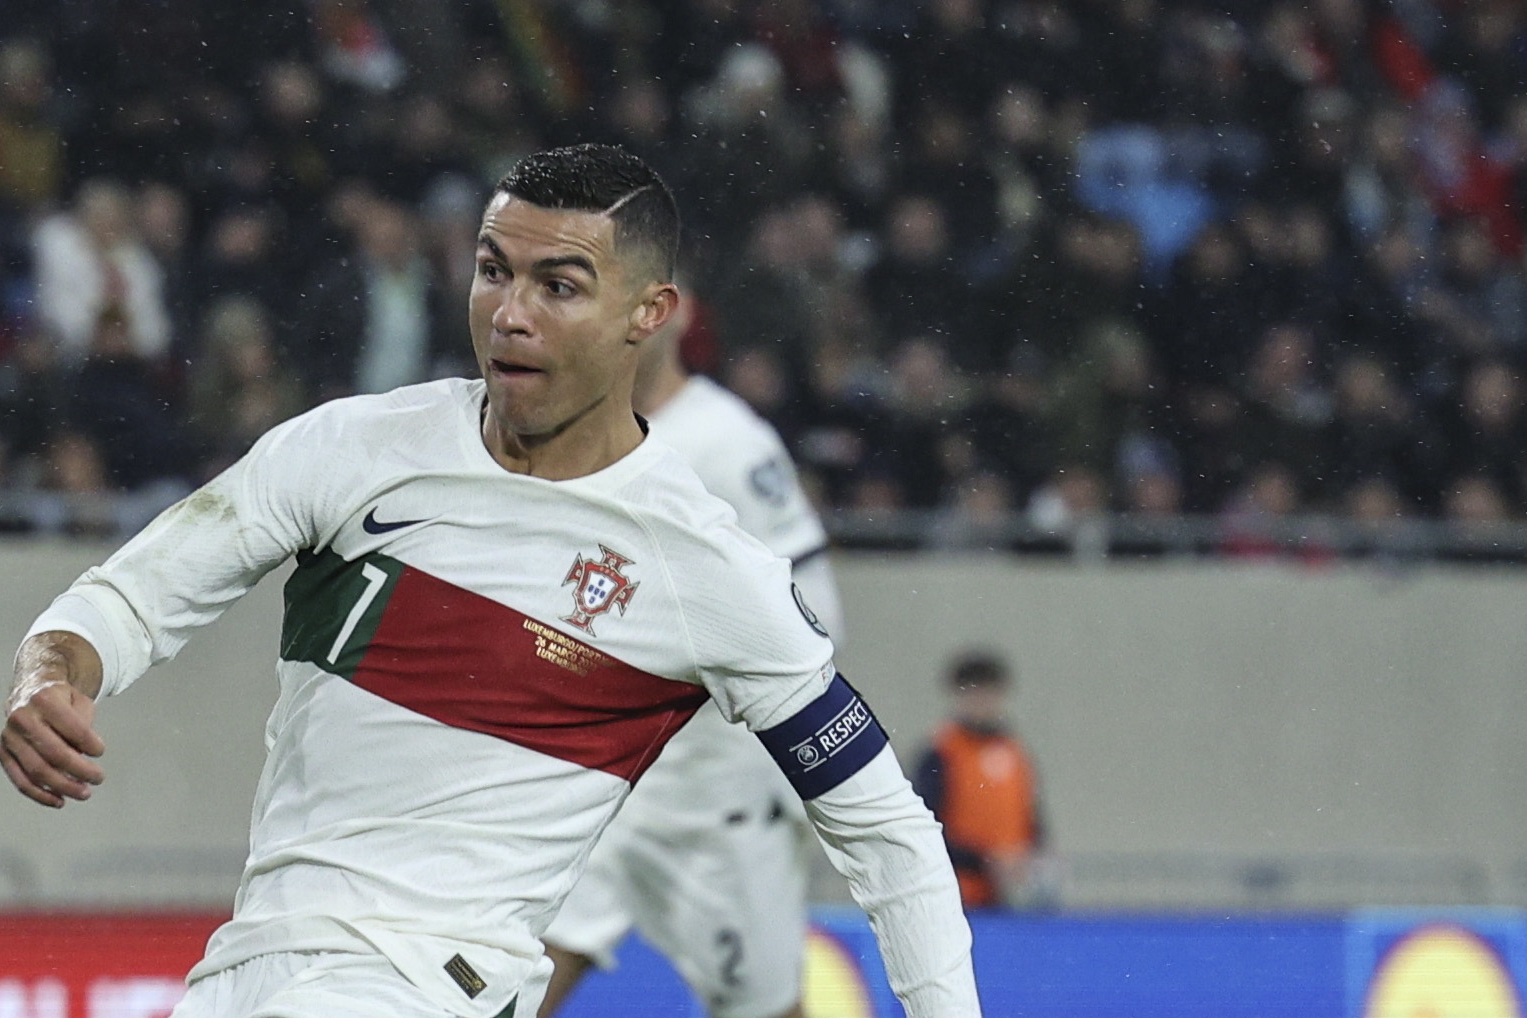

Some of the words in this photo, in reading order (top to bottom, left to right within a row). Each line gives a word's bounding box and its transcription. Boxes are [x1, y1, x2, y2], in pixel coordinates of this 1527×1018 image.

[326, 562, 388, 665] 7
[819, 701, 868, 752] RESPECT
[717, 928, 744, 988] 2
